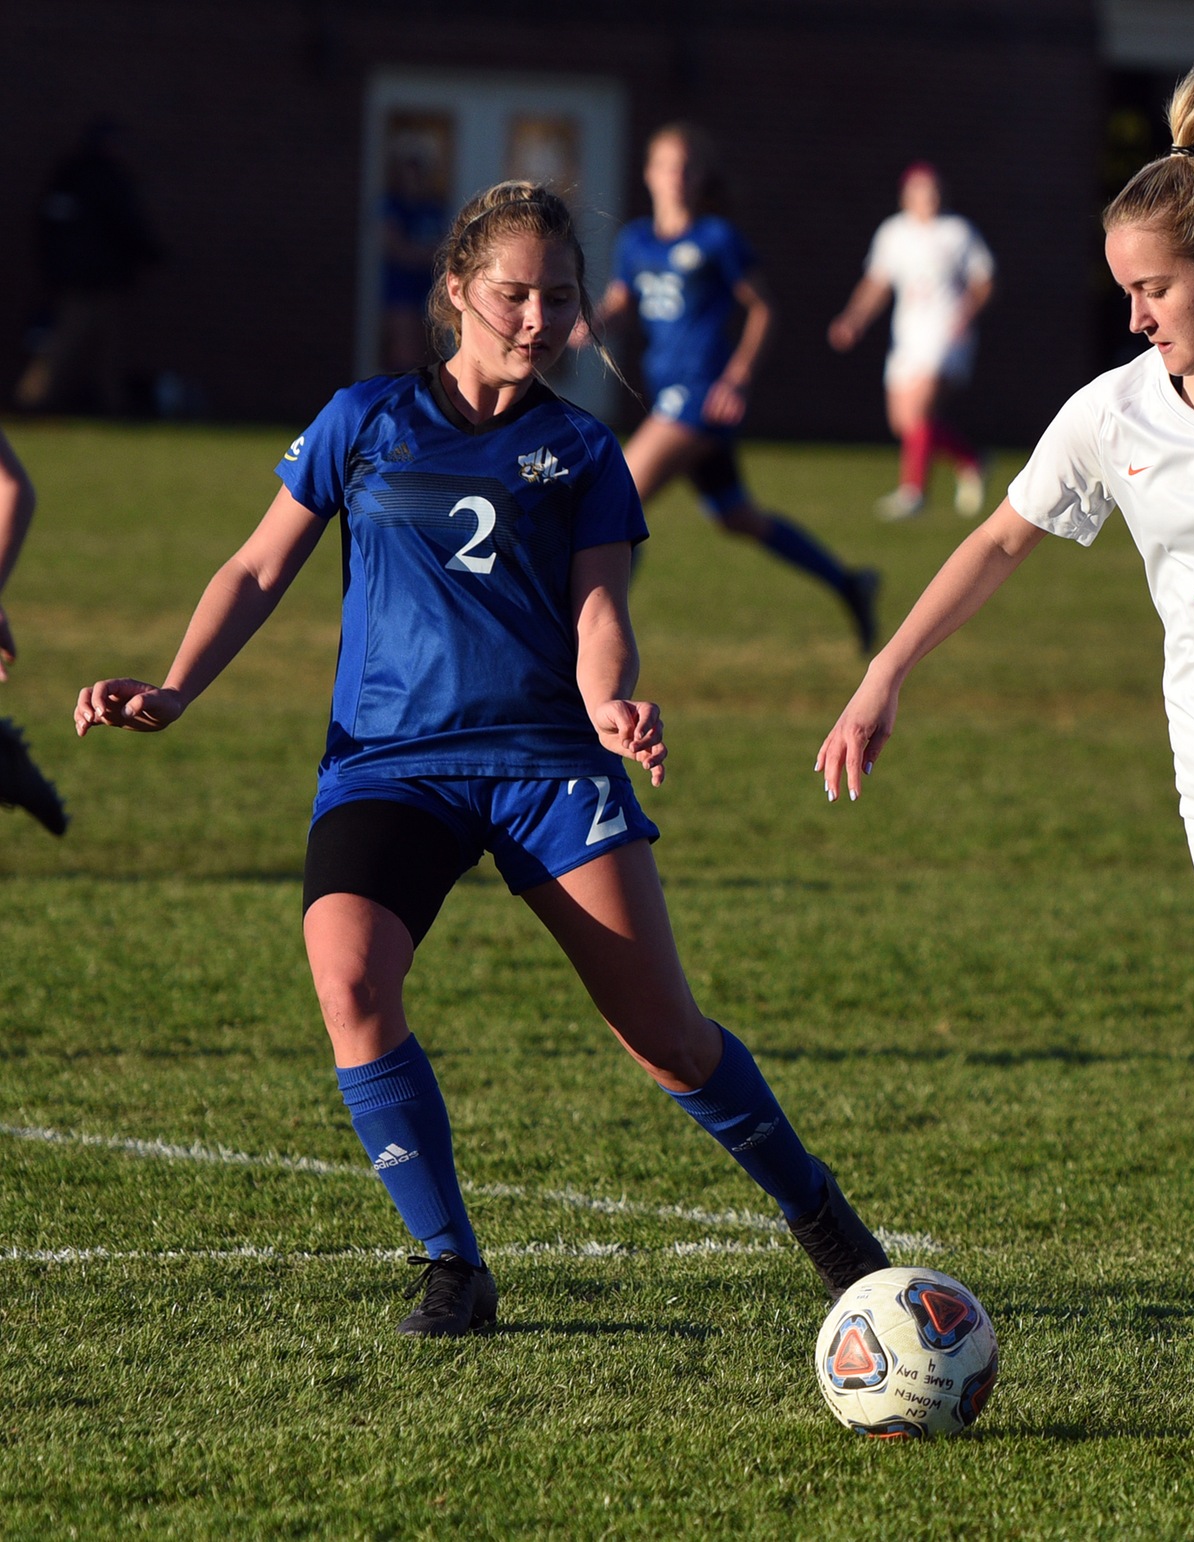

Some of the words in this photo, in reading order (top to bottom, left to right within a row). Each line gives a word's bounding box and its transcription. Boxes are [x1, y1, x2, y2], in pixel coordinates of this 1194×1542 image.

[445, 495, 497, 575] 2
[567, 775, 628, 847] 2
[373, 1150, 419, 1171] adidas
[896, 1364, 918, 1380] DAY
[927, 1358, 936, 1373] 4
[923, 1375, 954, 1390] GAME
[894, 1388, 942, 1410] WOMEN
[905, 1408, 927, 1418] CN
